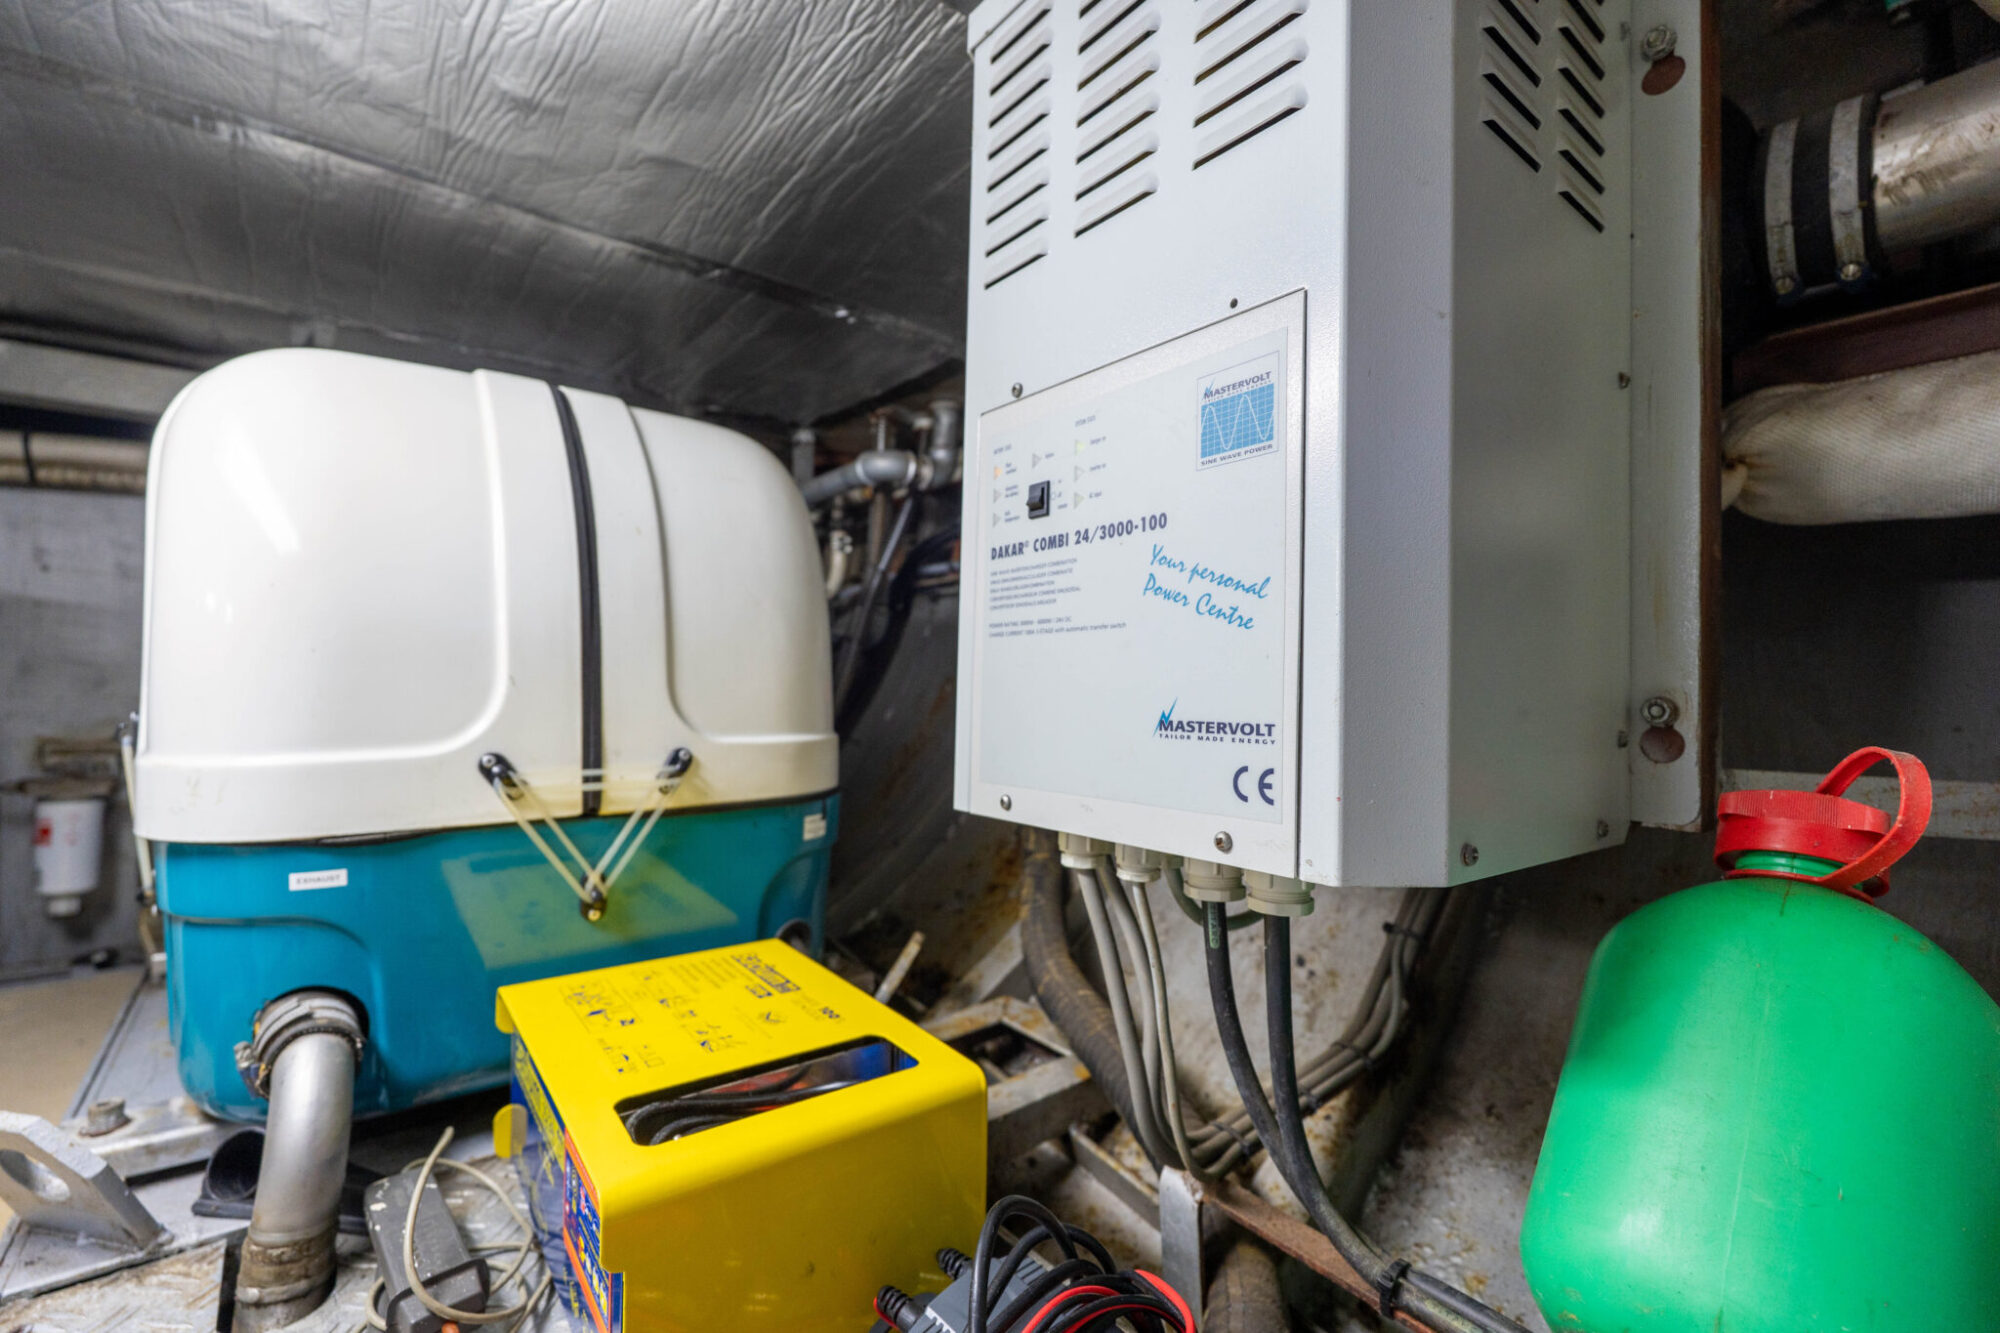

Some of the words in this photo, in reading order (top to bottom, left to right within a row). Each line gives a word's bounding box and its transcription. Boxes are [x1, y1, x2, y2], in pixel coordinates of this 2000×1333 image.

[1203, 371, 1272, 399] MASTERVOLT
[1201, 458, 1218, 467] SINE
[1220, 451, 1242, 462] WAVE
[1244, 444, 1273, 457] POWER
[1033, 532, 1069, 553] COMBI
[1074, 512, 1168, 546] 24/3000-100
[1149, 545, 1185, 572] Your
[1189, 560, 1272, 600] personal
[1143, 573, 1191, 605] Power
[1194, 593, 1256, 630] Centre
[1159, 720, 1275, 736] MASTERVOLT
[1231, 737, 1276, 745] ENERGY
[1232, 765, 1275, 806] CE
